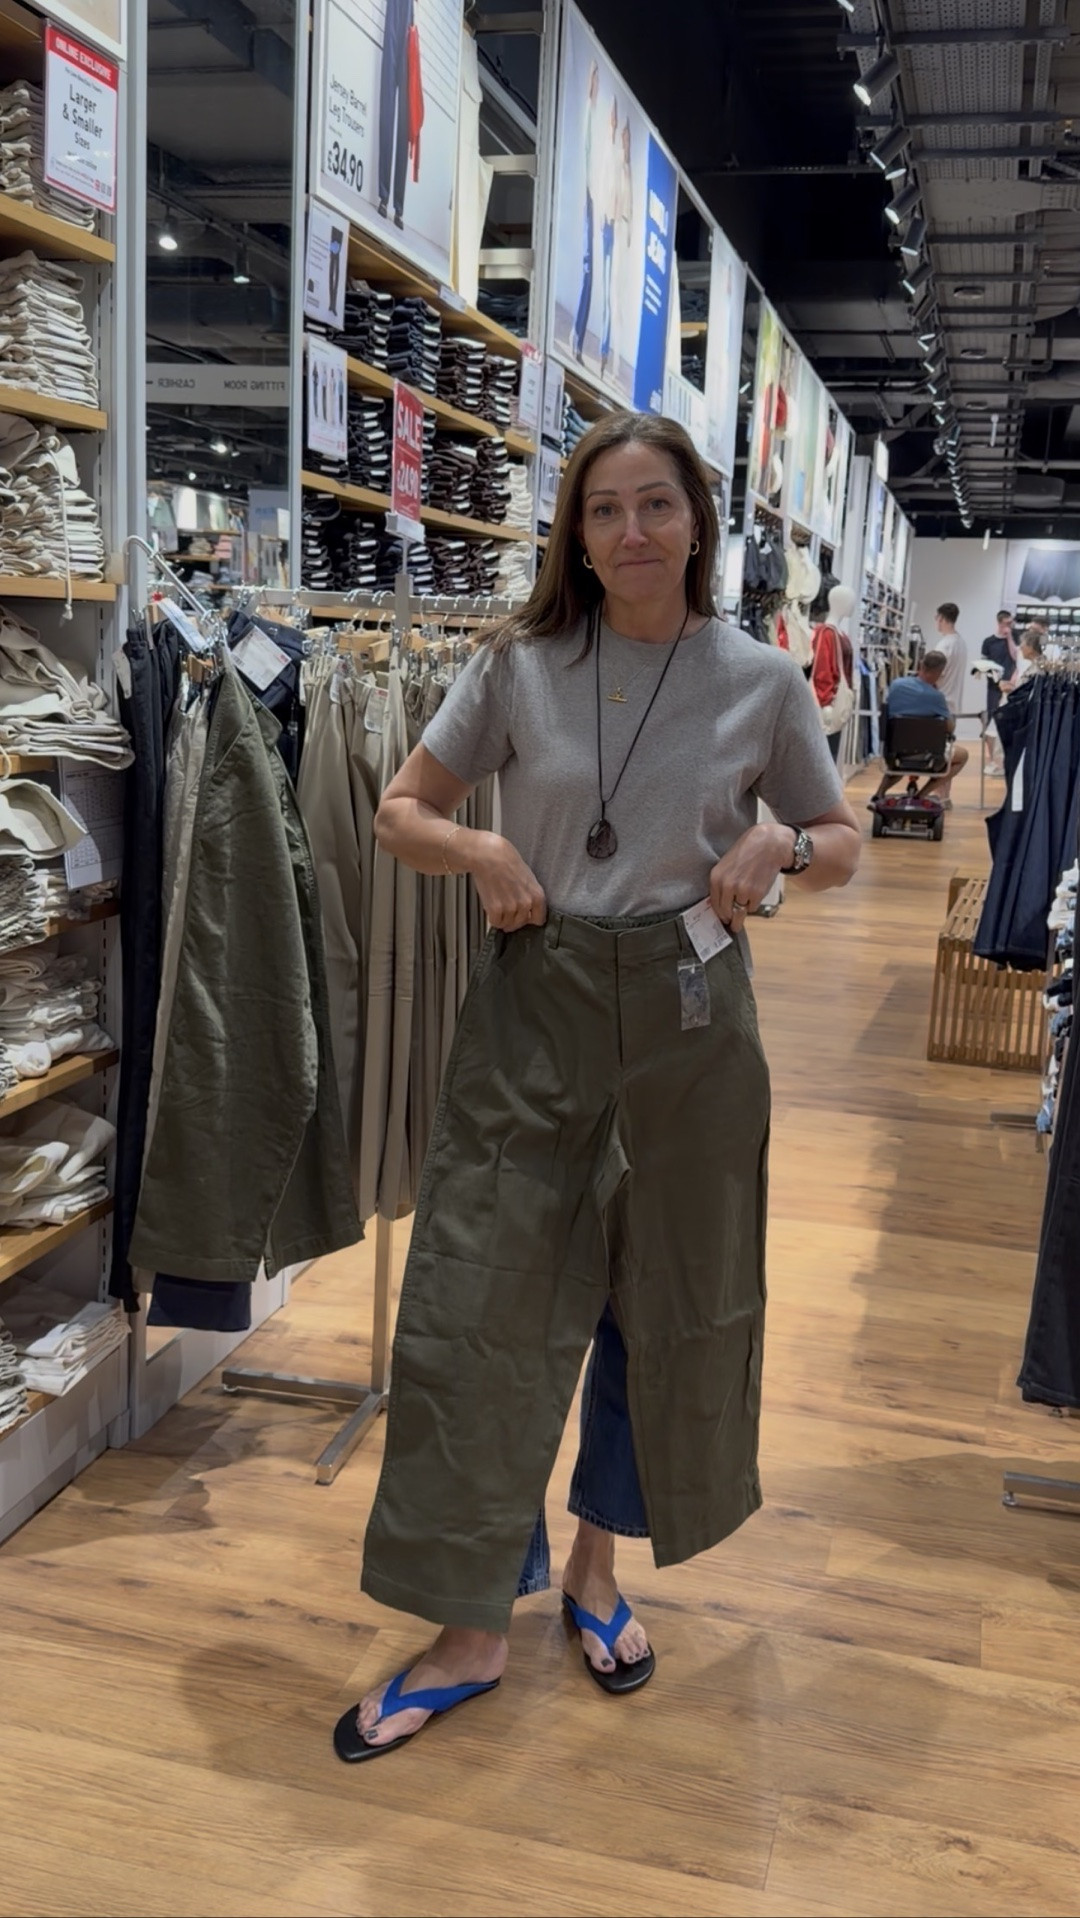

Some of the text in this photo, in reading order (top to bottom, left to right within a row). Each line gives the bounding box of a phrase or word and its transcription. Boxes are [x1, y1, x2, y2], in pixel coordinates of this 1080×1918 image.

[69, 83, 97, 114] Larger
[329, 96, 341, 123] Leg
[62, 103, 103, 139] & Smaller
[74, 131, 90, 150] Sizes
[327, 140, 364, 193] £34.90
[396, 400, 422, 452] SALE
